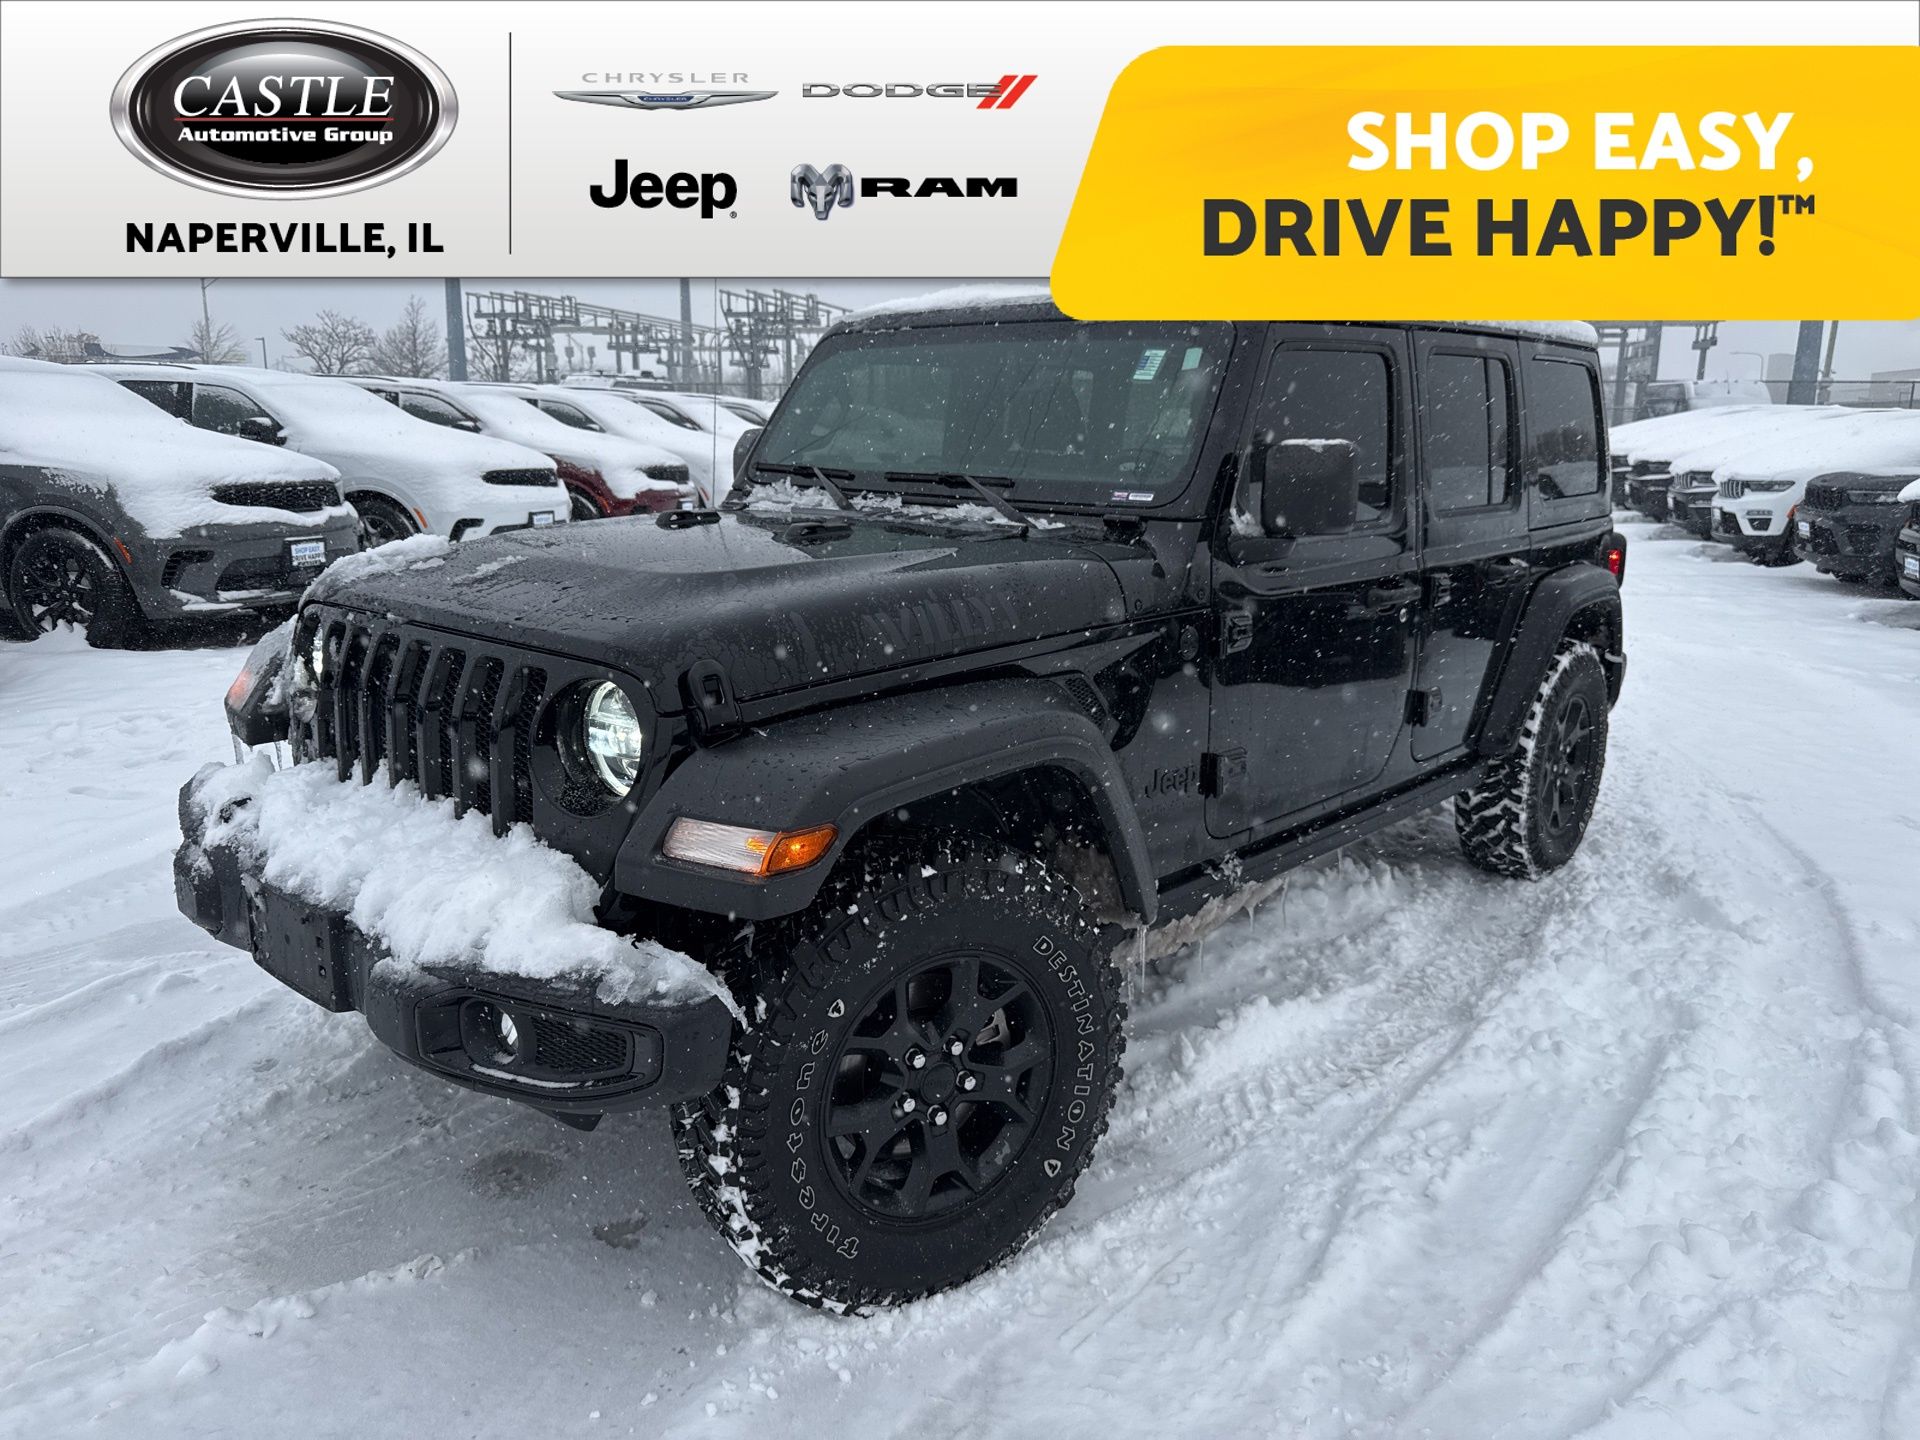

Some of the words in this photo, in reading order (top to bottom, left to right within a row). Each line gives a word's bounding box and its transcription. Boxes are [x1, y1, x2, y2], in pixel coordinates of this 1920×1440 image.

[1144, 766, 1197, 799] Jeep
[787, 1028, 860, 1260] Firestone
[1032, 935, 1096, 1152] DESTINATION
